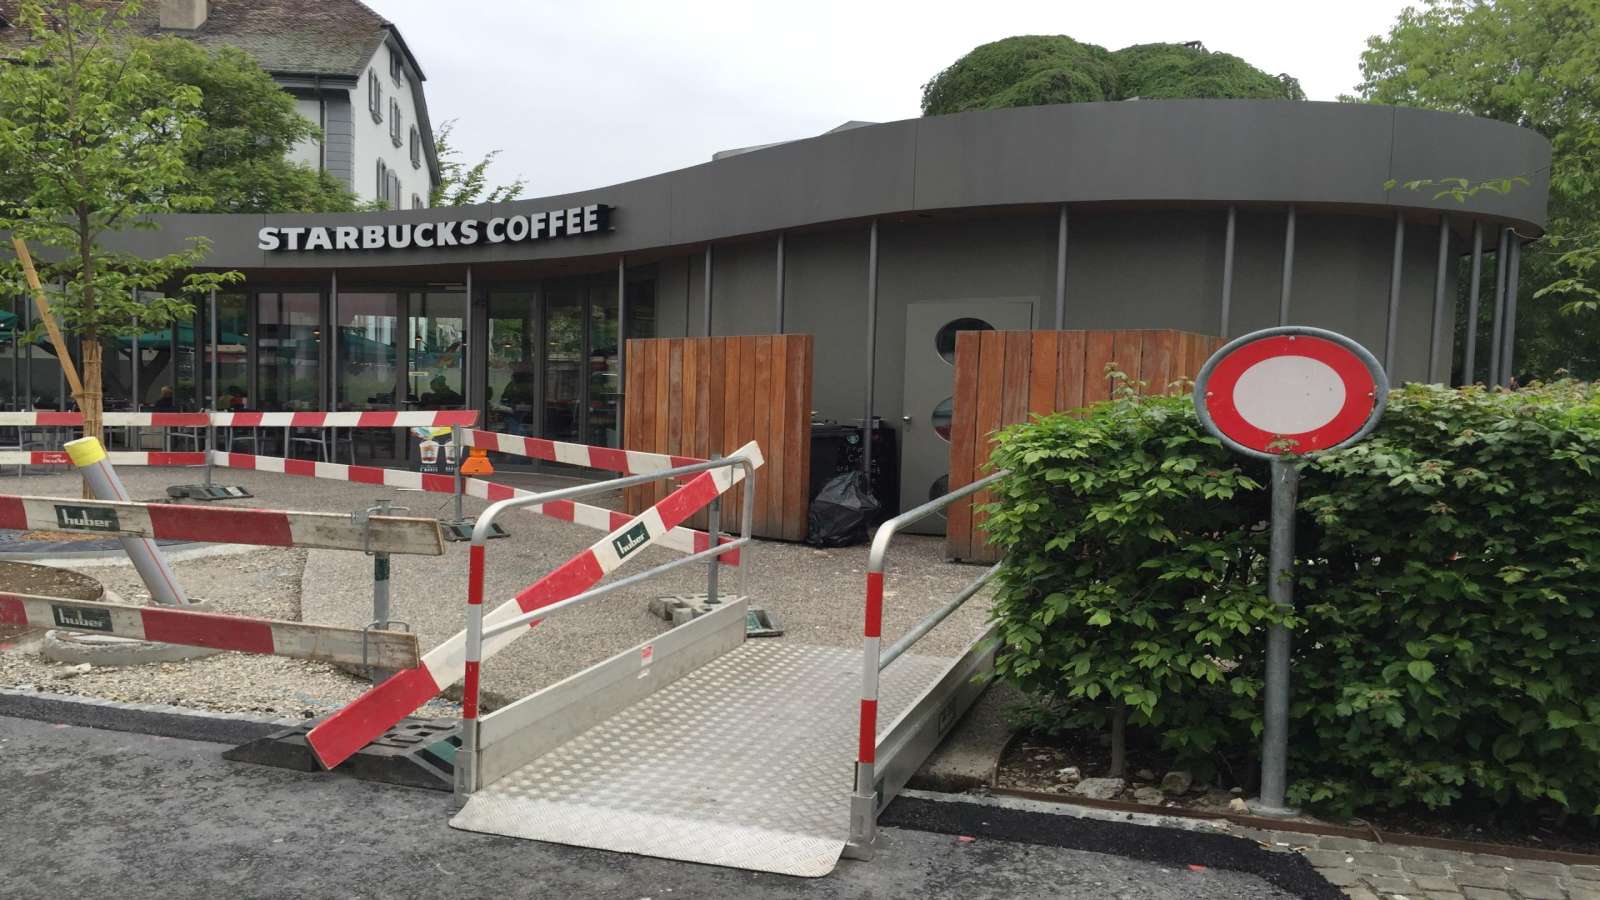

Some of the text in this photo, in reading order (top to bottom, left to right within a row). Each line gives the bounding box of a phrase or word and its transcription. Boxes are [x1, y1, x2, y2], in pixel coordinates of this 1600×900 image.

[257, 204, 599, 250] STARBUCKS COFFEE
[62, 508, 112, 528] huber
[616, 533, 645, 554] huber
[58, 607, 104, 628] huber
